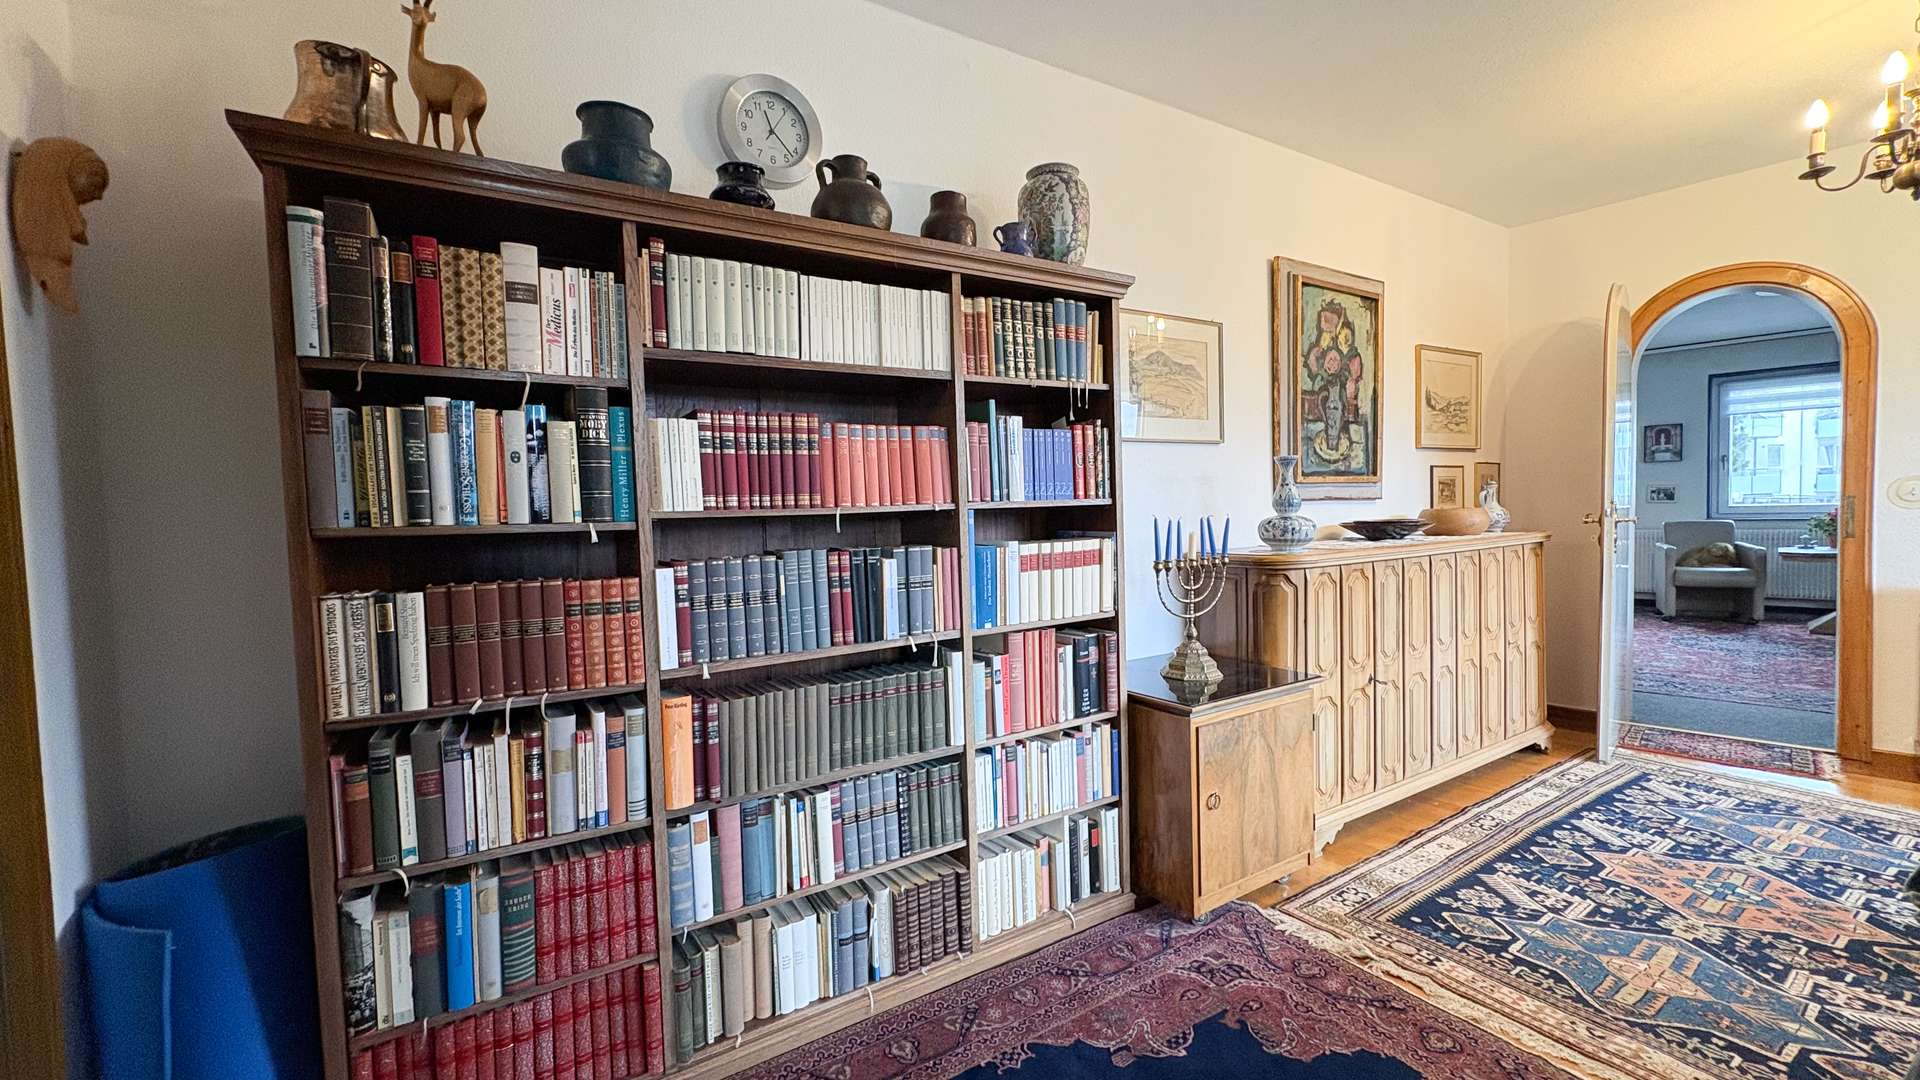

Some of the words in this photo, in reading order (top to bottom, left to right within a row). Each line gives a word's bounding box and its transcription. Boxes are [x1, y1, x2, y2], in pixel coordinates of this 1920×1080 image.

[753, 101, 761, 111] 11
[766, 100, 776, 110] 12
[744, 108, 754, 119] 10
[740, 121, 747, 131] 9
[790, 118, 797, 128] 2
[746, 138, 753, 147] 8
[795, 133, 802, 142] 3
[757, 148, 763, 157] 7
[770, 155, 776, 165] 6
[783, 153, 790, 163] 5
[546, 298, 562, 348] Medicus
[579, 419, 607, 429] MOBY
[616, 411, 626, 443] Plexus
[582, 429, 606, 438] DICK
[618, 455, 627, 485] Miller
[620, 488, 630, 518] Henry
